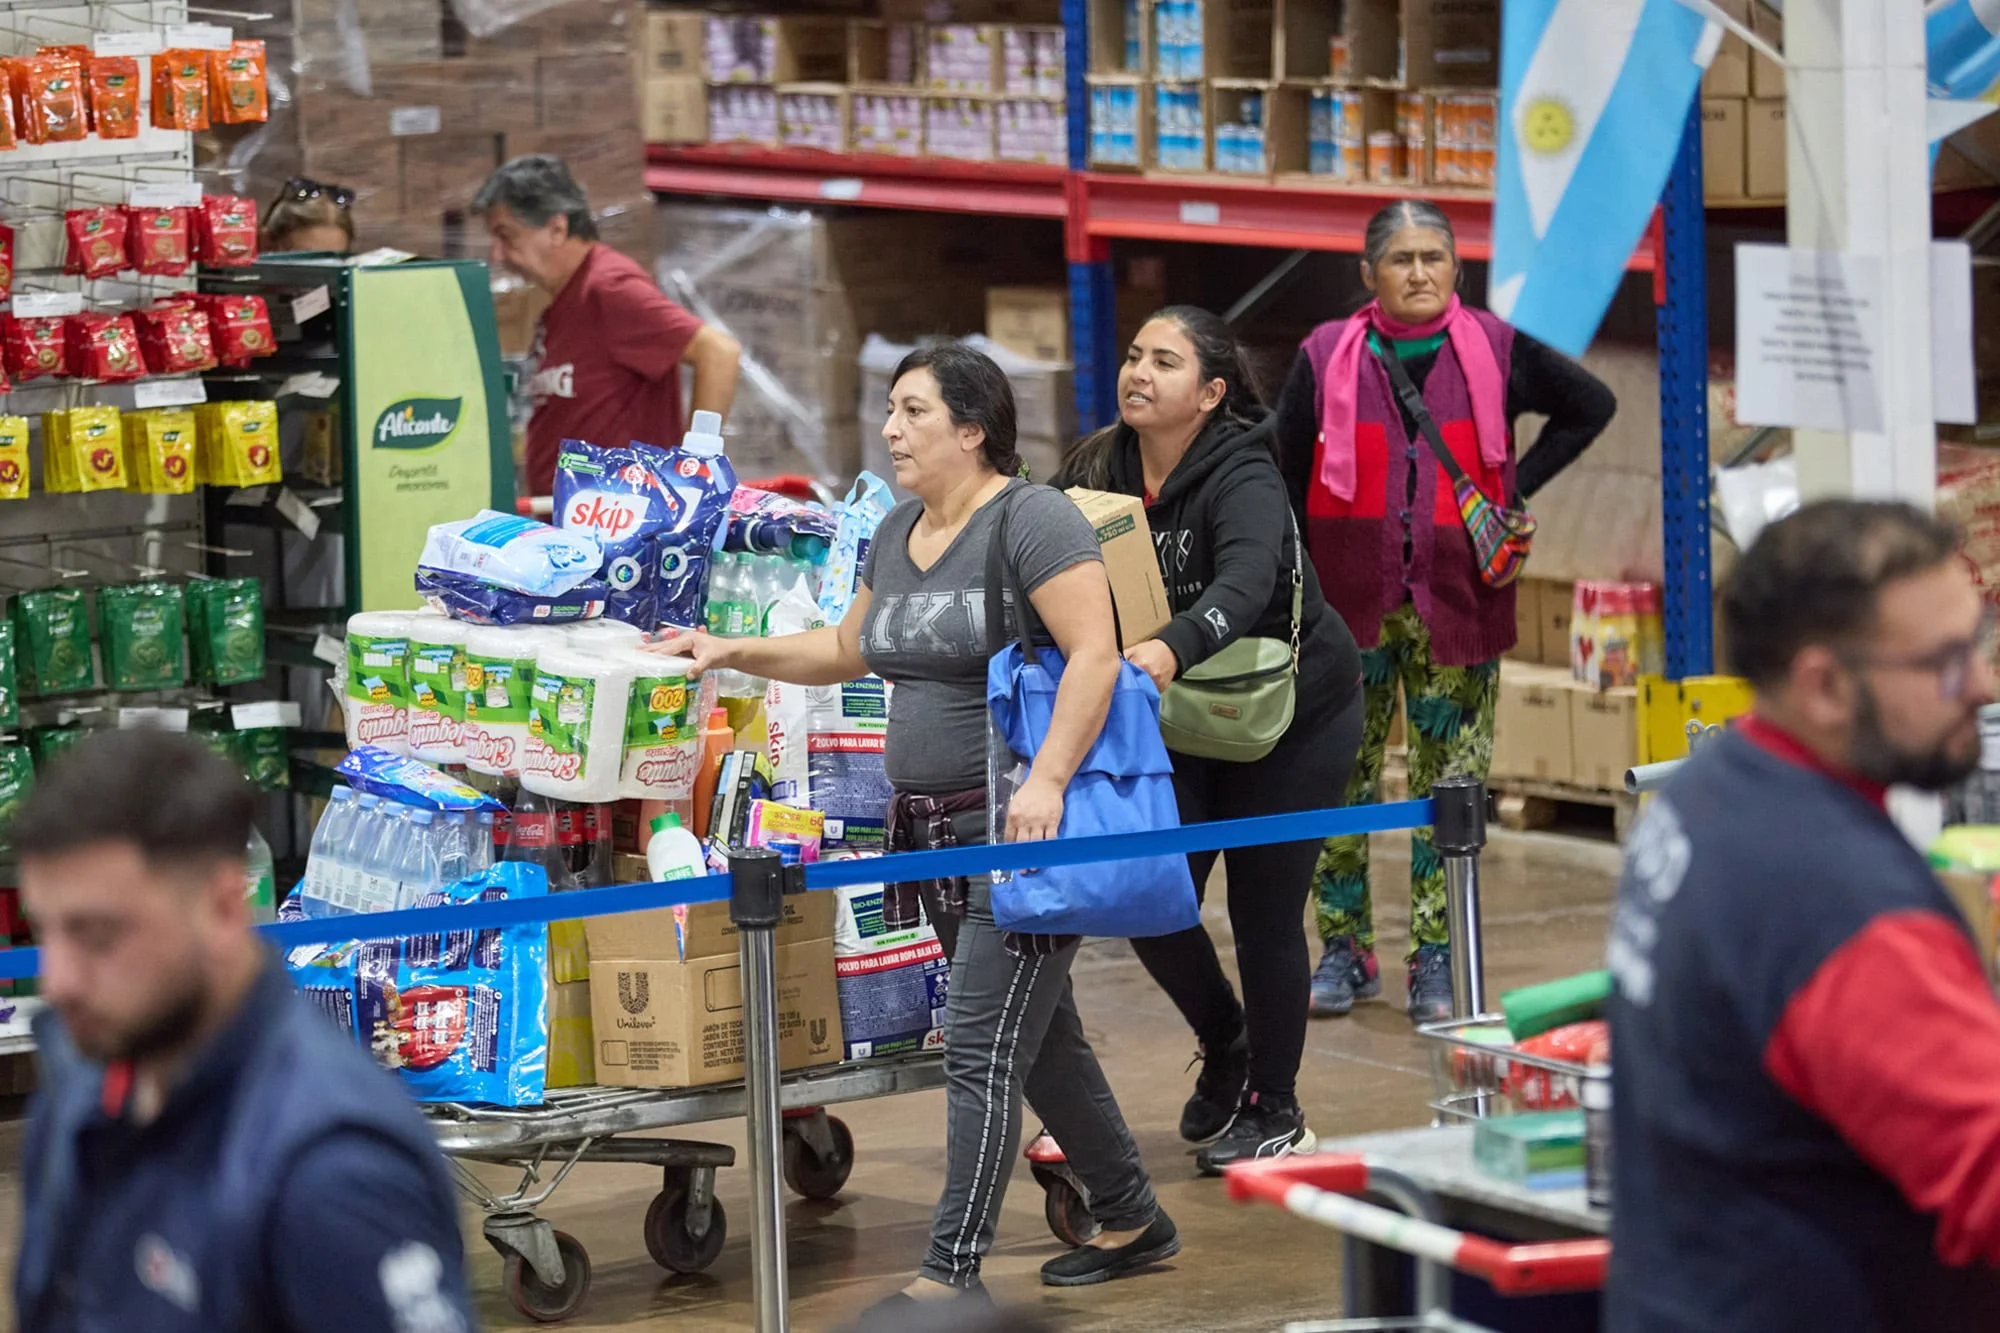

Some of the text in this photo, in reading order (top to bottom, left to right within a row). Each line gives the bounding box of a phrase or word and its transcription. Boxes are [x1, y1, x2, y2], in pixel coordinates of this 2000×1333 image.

[378, 406, 456, 442] Alicante
[571, 496, 635, 538] skip
[651, 687, 686, 710] 200
[410, 715, 466, 749] legante
[768, 721, 785, 768] skip
[840, 738, 858, 748] PARA
[859, 738, 879, 748] LAVAR
[809, 816, 824, 827] 60
[837, 961, 860, 972] POLVO
[861, 959, 879, 969] PARA
[880, 954, 900, 966] LAVAR
[900, 950, 916, 961] ROPA
[917, 946, 932, 958] BAJA
[617, 972, 649, 1014] U
[616, 1016, 656, 1029] Unilever
